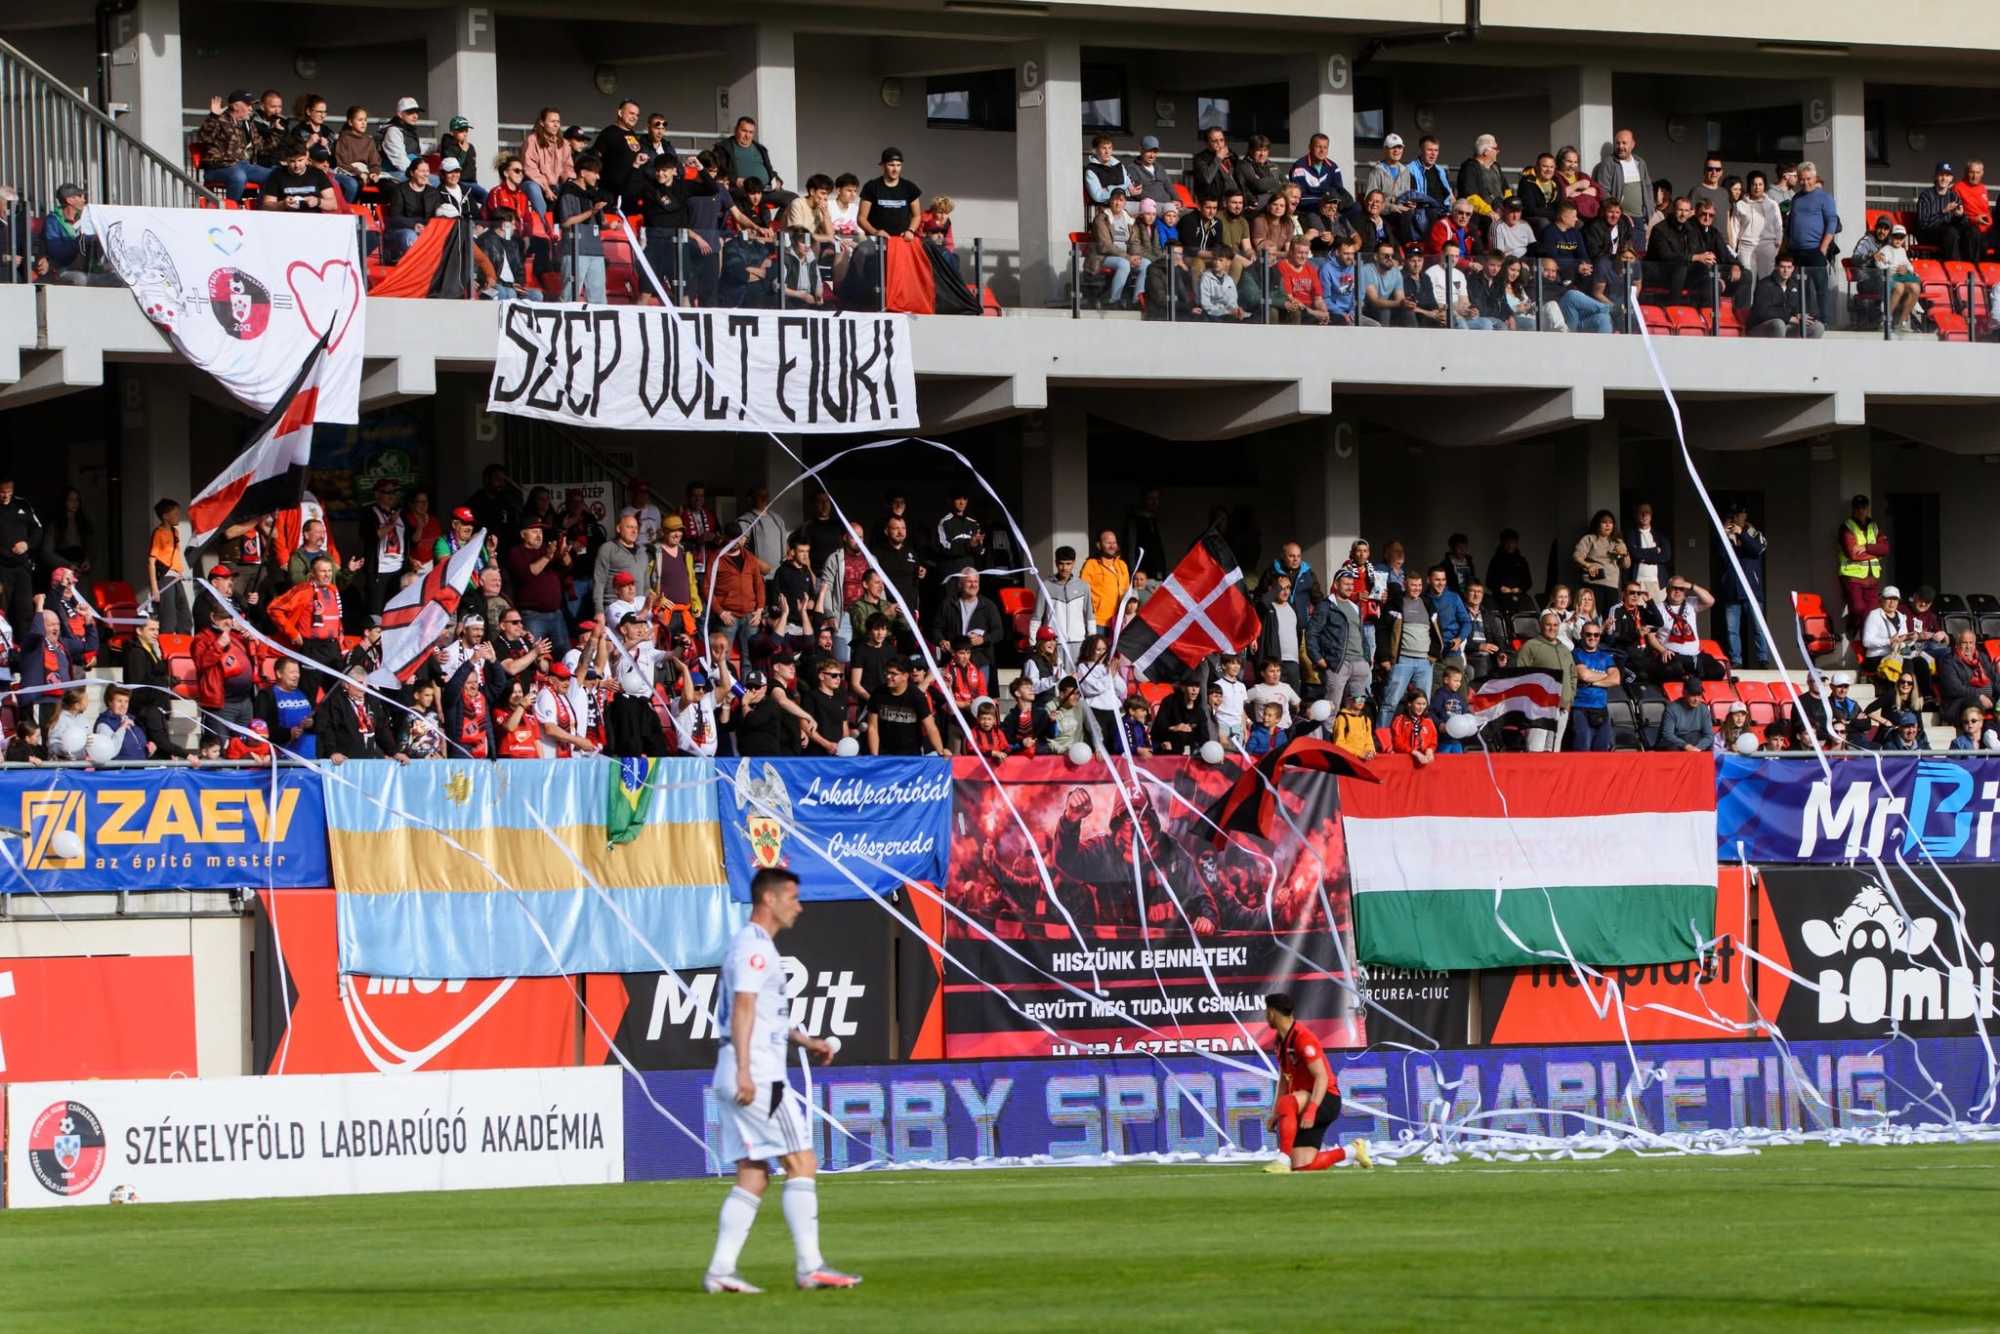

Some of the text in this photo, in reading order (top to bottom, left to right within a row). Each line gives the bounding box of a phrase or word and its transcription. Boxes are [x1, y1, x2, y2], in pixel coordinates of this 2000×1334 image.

[468, 8, 488, 46] F
[1023, 60, 1038, 88] G
[1327, 53, 1347, 89] G
[1810, 99, 1825, 124] G
[494, 303, 623, 418] SZÉP
[776, 311, 900, 424] FIÚK!
[1333, 421, 1353, 459] C
[96, 788, 301, 845] ZAEV
[1797, 761, 2000, 858] MrBi
[95, 855, 286, 872] az építő mester
[1052, 946, 1248, 972] HISZÜNK BENNETEK!
[1025, 998, 1087, 1019] EGYÜTT
[1131, 997, 1194, 1016] TUDJUK
[703, 1054, 1888, 1172] RBY SPORS MARKETING
[125, 1103, 605, 1166] SZÉKELYFÖLD LABDARÚGÓ AKADÉMIA
